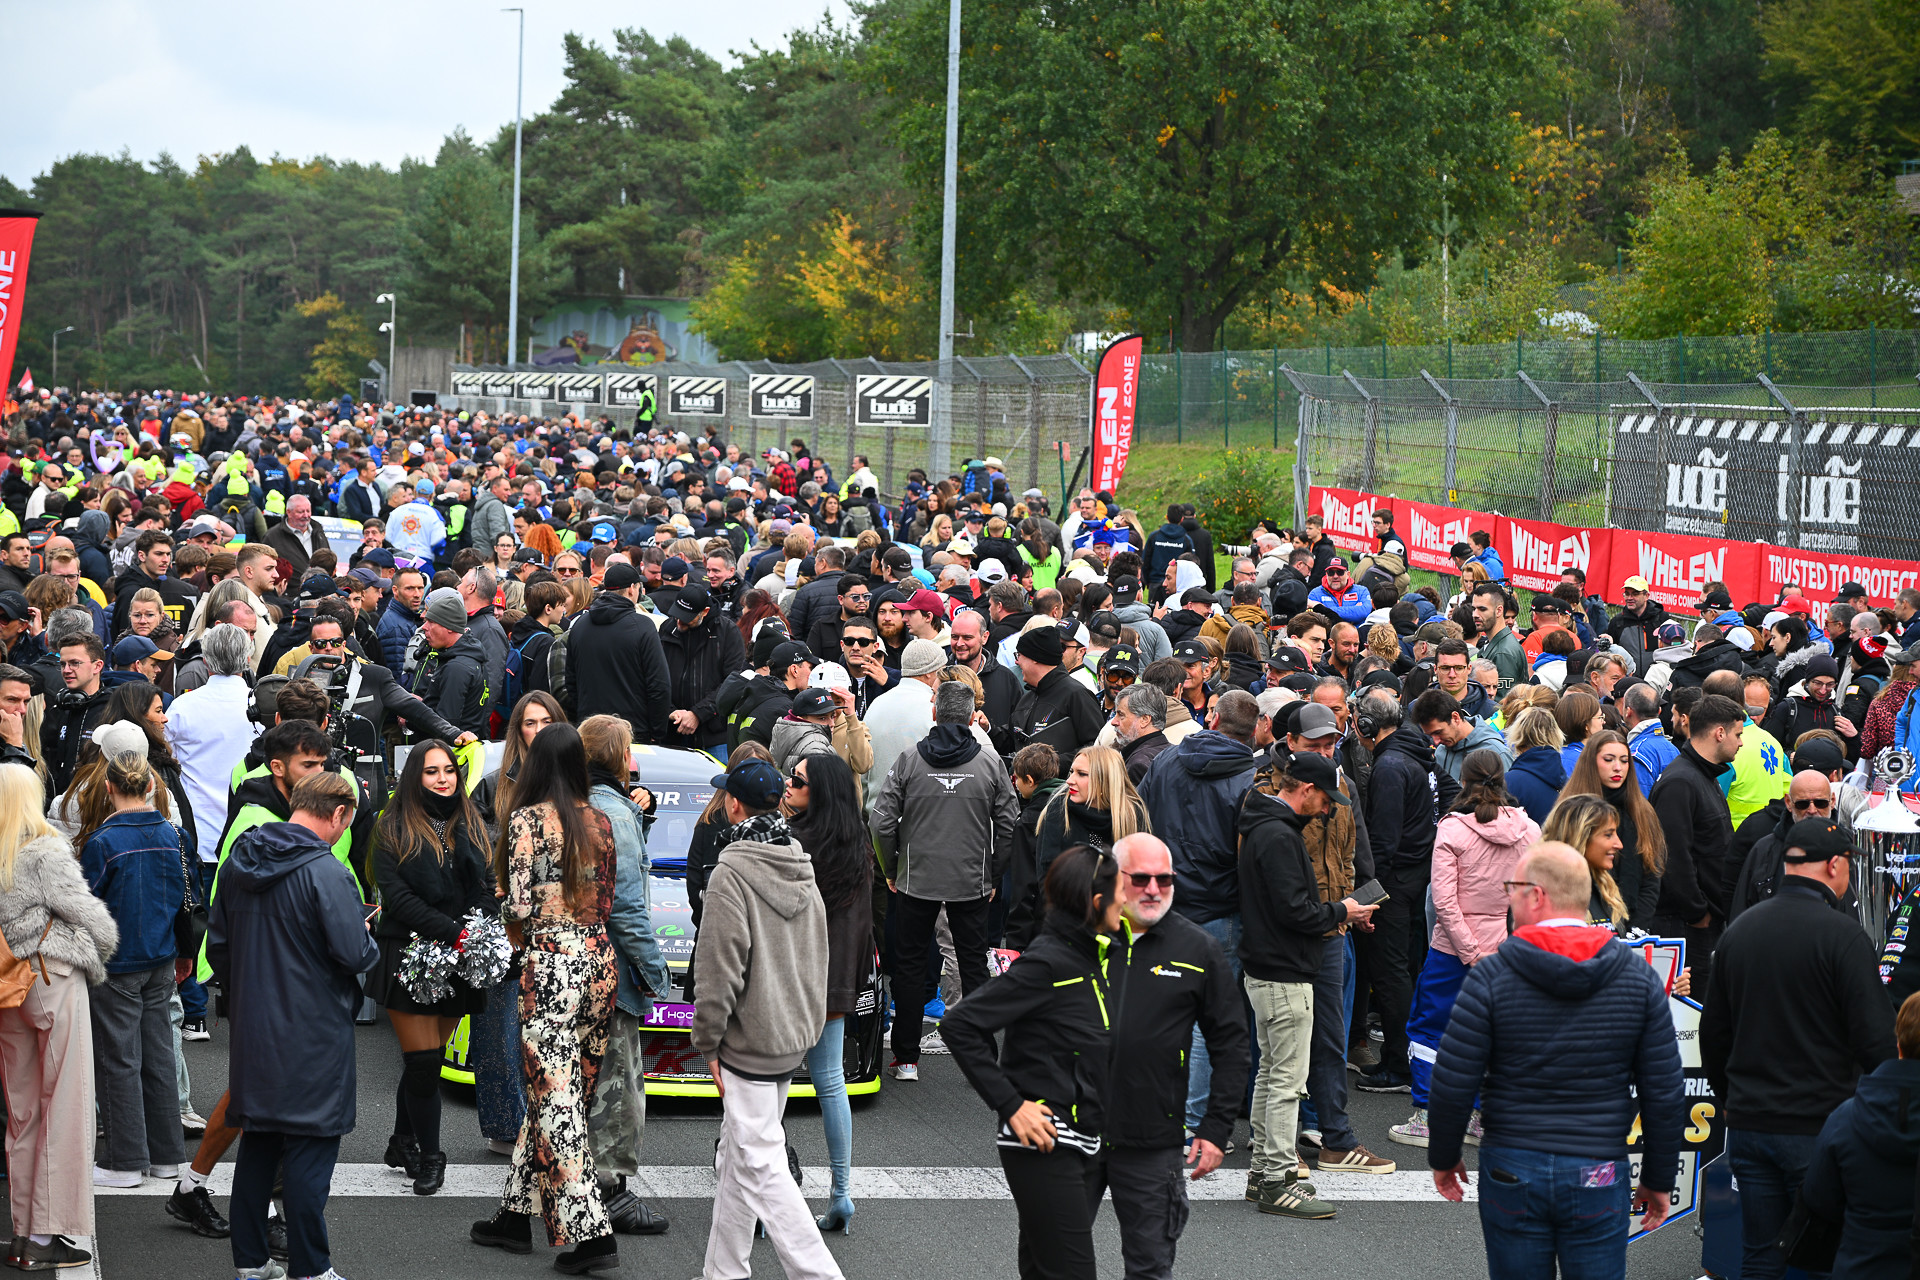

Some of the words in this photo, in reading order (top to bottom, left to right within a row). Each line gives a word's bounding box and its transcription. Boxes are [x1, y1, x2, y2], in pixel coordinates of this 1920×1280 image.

[1123, 355, 1135, 408] ZONE
[1321, 490, 1376, 538] WHELEN
[1411, 508, 1470, 553] WHELEN
[1511, 520, 1590, 576] WHELEN
[1638, 539, 1725, 592] WHELEN
[1769, 554, 1828, 591] TRUSTED
[1829, 563, 1851, 593] TO
[1851, 566, 1918, 600] PROTECT
[1115, 650, 1132, 661] 24
